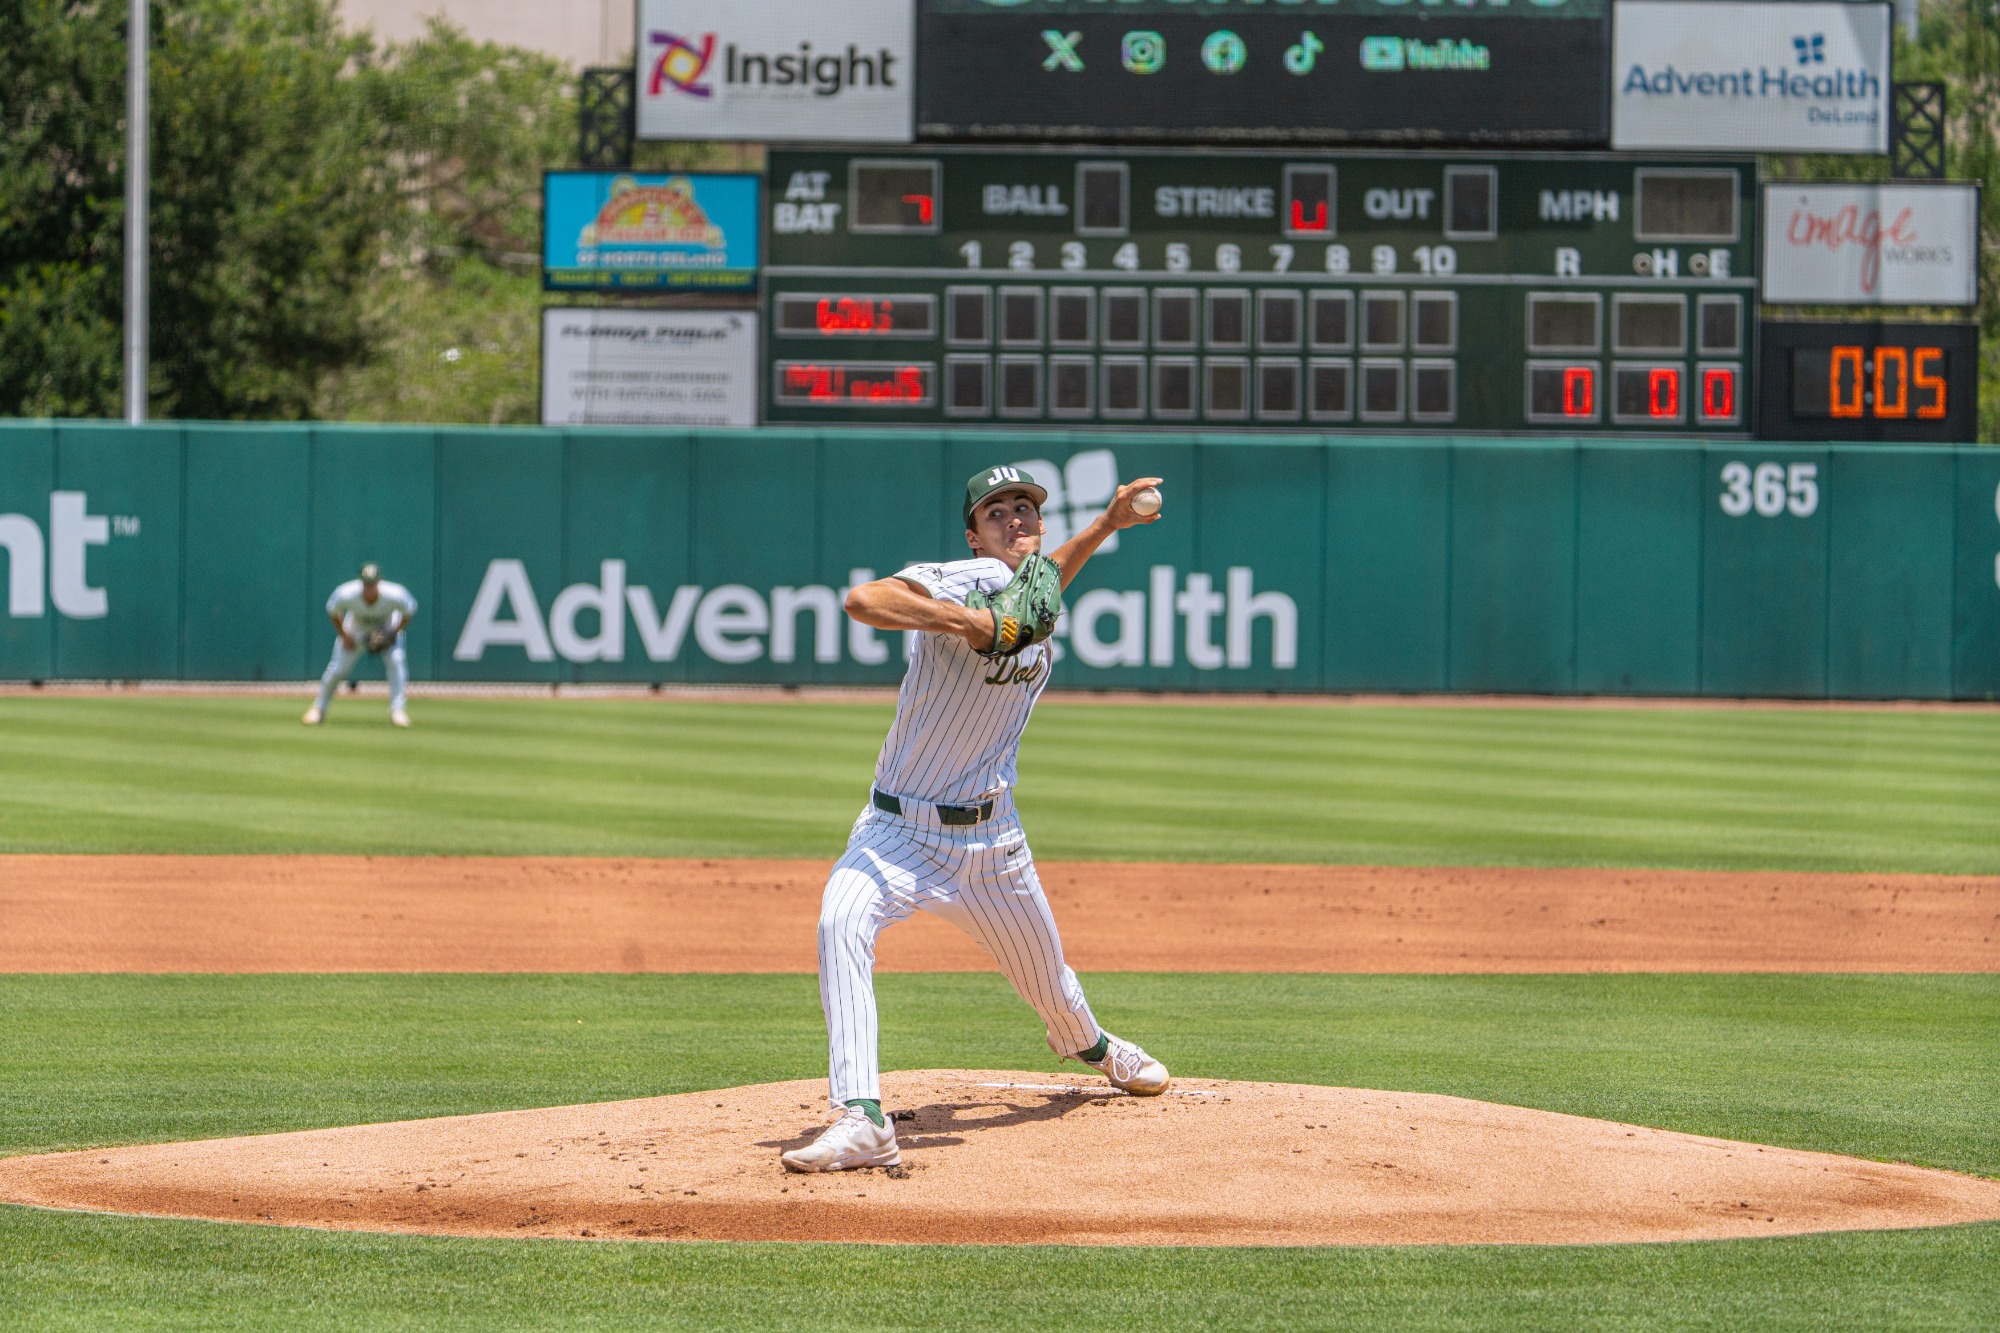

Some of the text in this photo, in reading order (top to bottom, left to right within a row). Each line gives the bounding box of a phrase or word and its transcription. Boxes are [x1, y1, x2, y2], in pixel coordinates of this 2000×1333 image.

[726, 42, 895, 96] Insight
[785, 171, 831, 199] AT
[982, 184, 1069, 216] BALL
[1155, 186, 1275, 218] STRIKE
[1364, 188, 1434, 219] OUT
[1539, 189, 1620, 222] MPH
[774, 203, 841, 234] BAT
[959, 240, 1457, 274] 1 2 3 4 5 6 7 8 9 10
[1556, 247, 1731, 278] R H E
[1564, 367, 1733, 418] 0 0 0
[988, 467, 1020, 486] JU
[1719, 461, 1818, 517] 365
